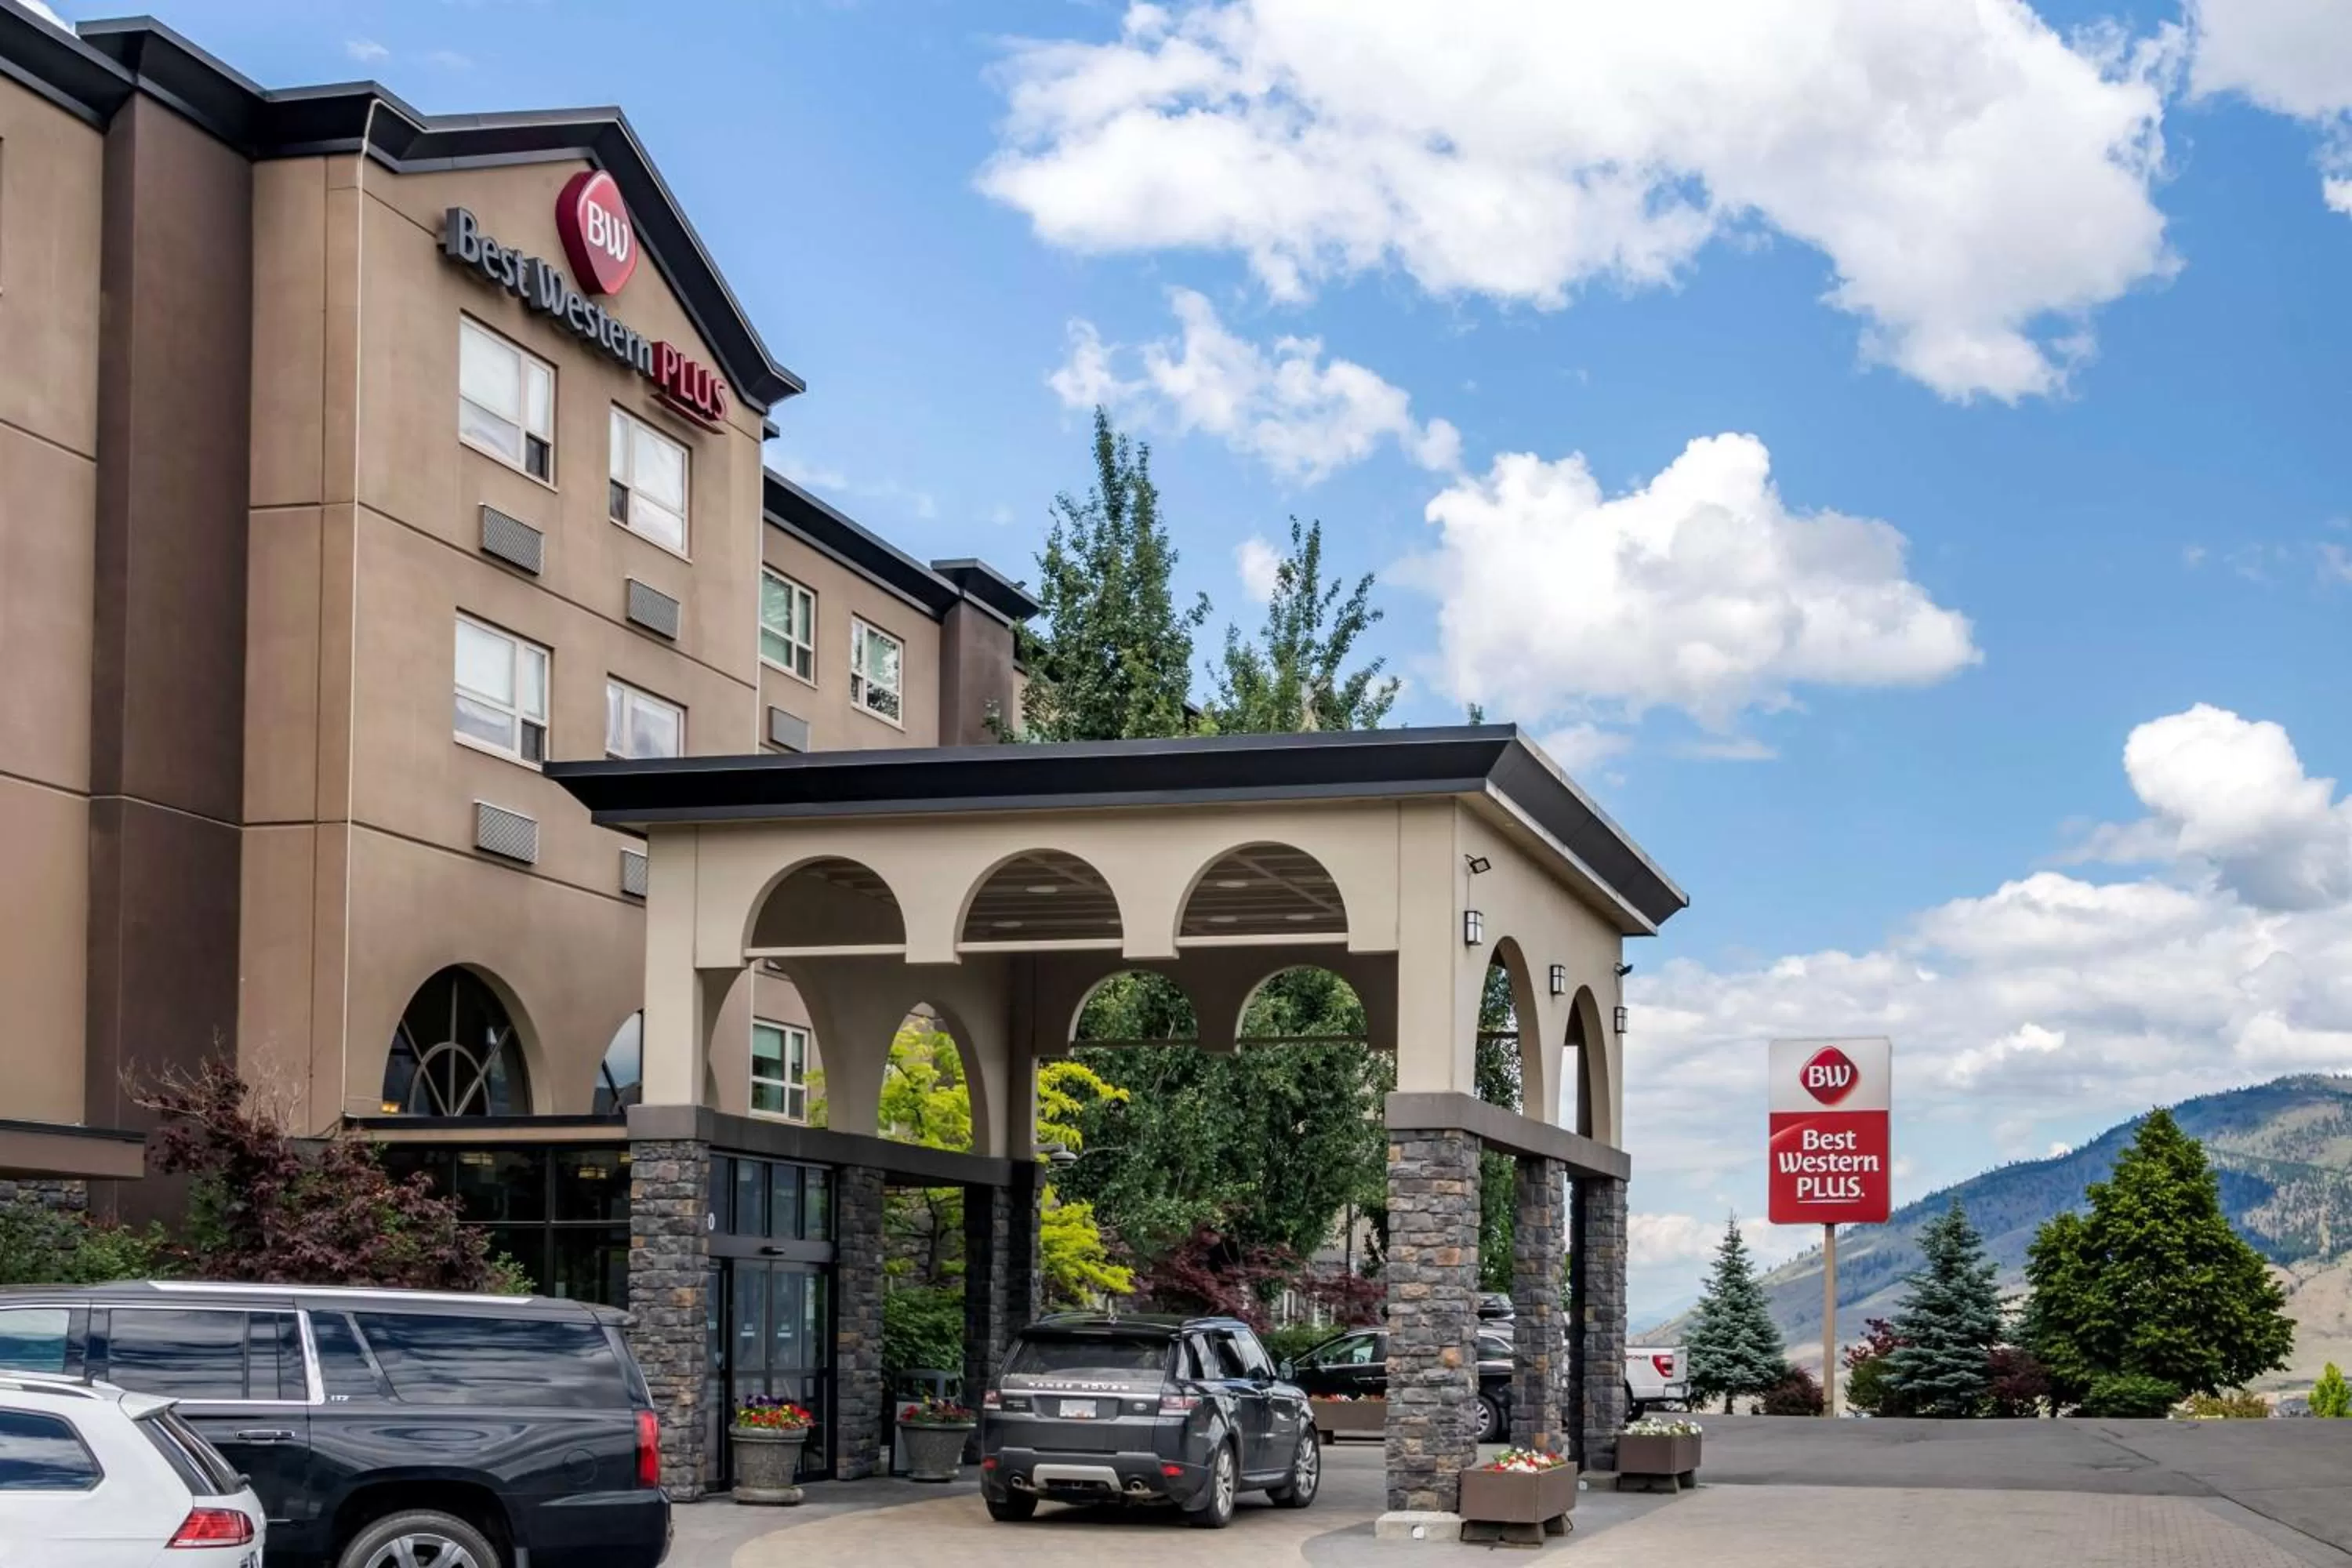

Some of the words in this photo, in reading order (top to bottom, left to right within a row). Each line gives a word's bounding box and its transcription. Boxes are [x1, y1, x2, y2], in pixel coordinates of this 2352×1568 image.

[586, 200, 629, 263] BW
[453, 206, 530, 299] Best
[535, 256, 654, 377] Western
[659, 341, 729, 420] PLUS
[1808, 1065, 1851, 1087] BW
[1802, 1129, 1857, 1150] Best
[1778, 1152, 1879, 1173] Western
